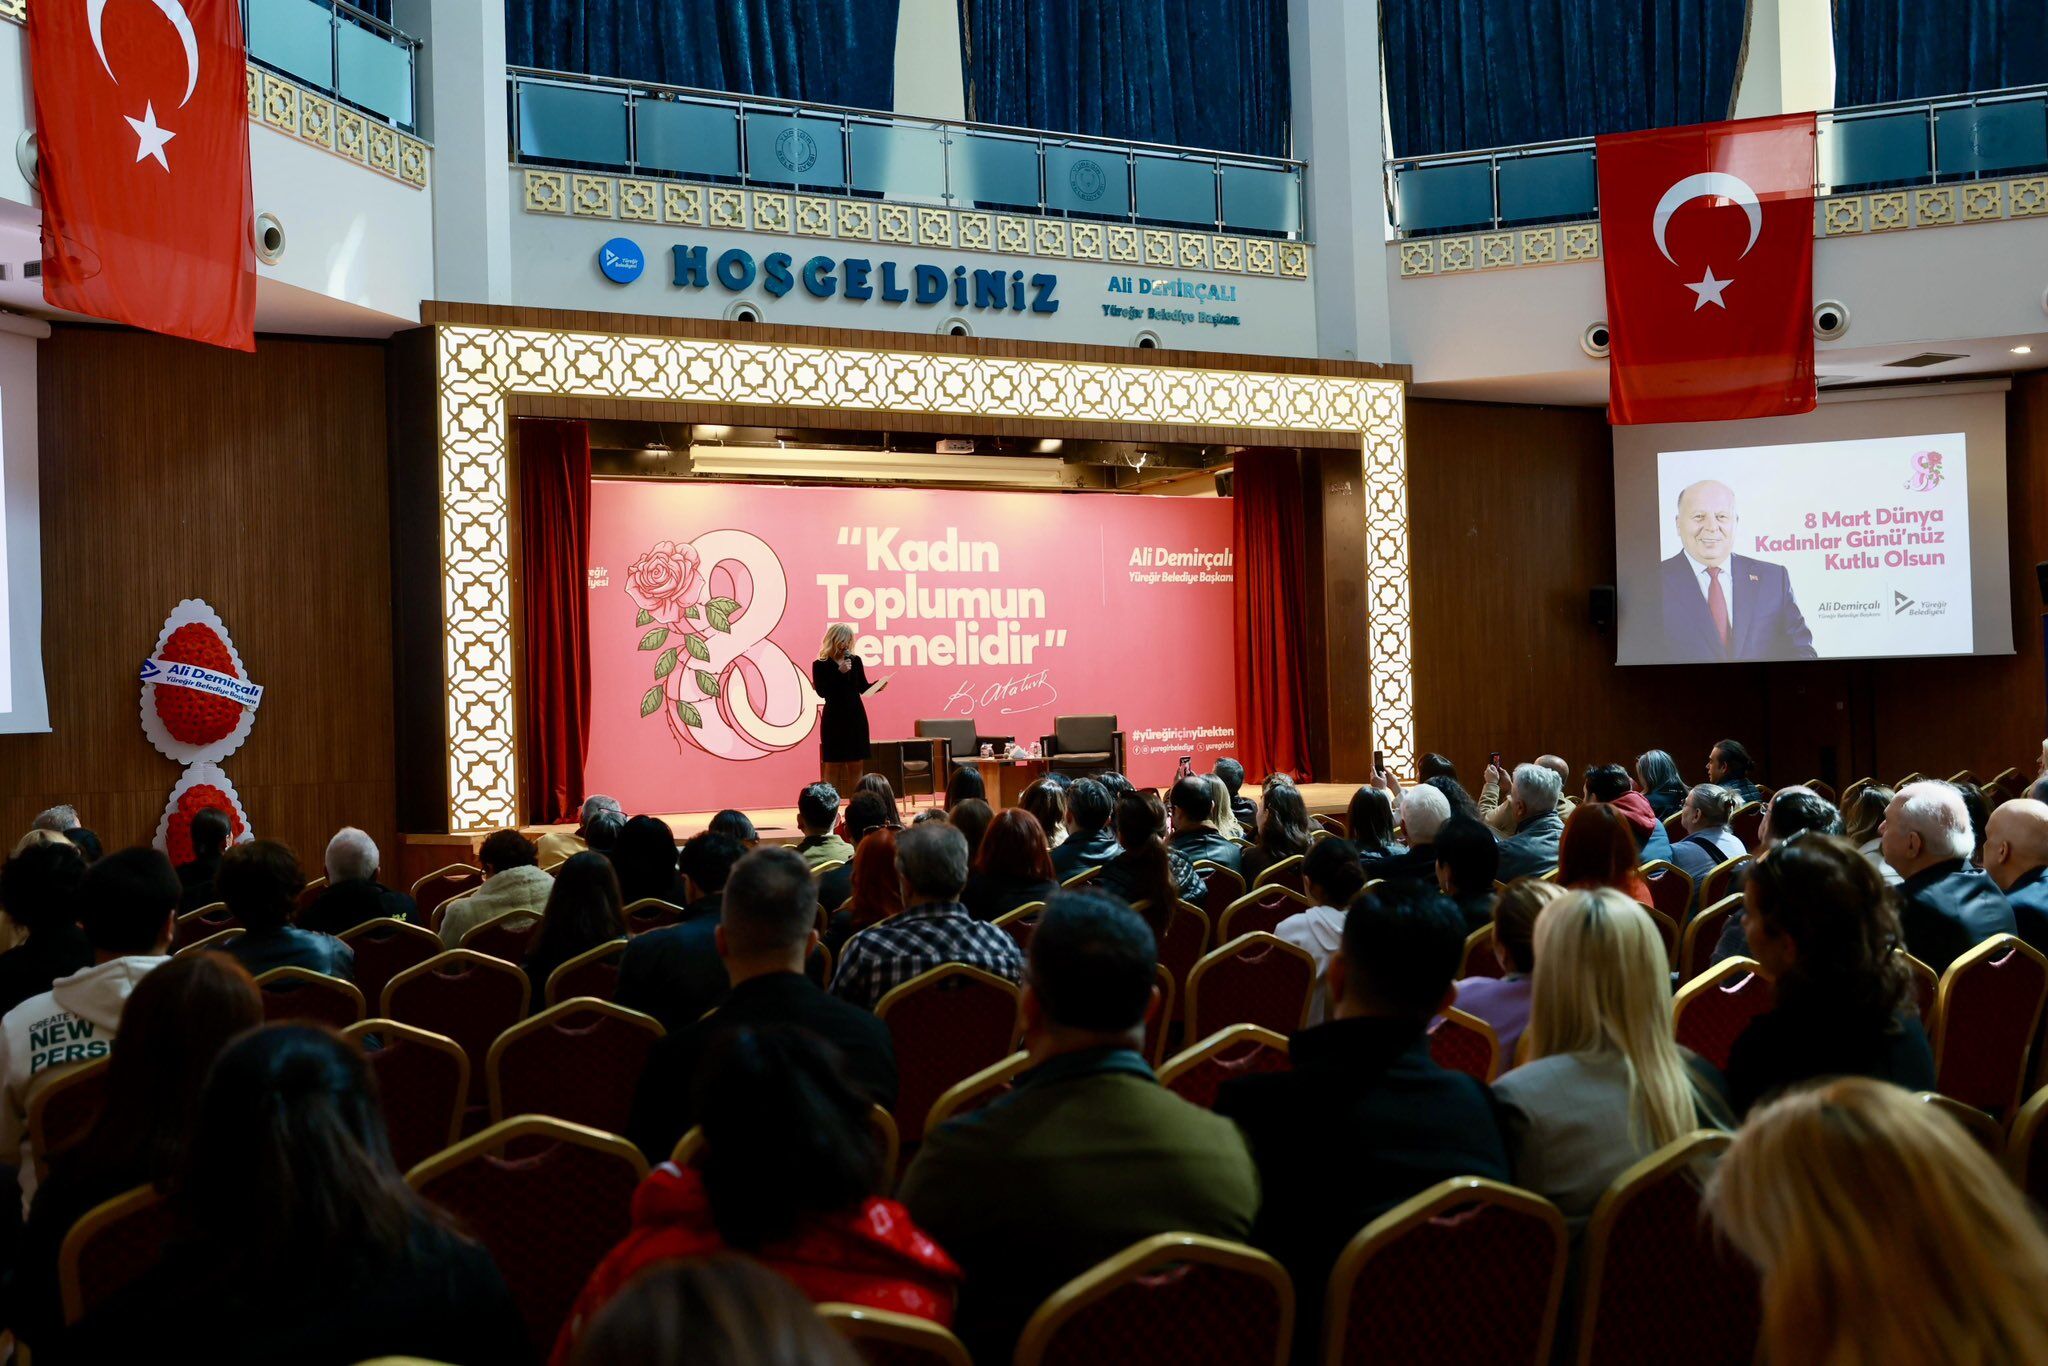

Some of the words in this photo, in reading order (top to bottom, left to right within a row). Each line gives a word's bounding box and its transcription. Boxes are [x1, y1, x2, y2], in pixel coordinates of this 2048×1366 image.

[1108, 276, 1133, 293] Ali
[1804, 513, 1817, 529] 8
[1822, 510, 1871, 528] Mart
[1876, 507, 1944, 526] Dünya
[1755, 533, 1842, 552] Kadınlar
[1129, 547, 1153, 566] Ali
[1155, 547, 1233, 571] Demirçalı
[1825, 552, 1879, 570] Kutlu
[1884, 549, 1945, 568] Olsun
[1129, 571, 1161, 584] Yüreğir
[1162, 572, 1199, 584] Belediye
[816, 573, 1046, 631] Toplumun
[1818, 602, 1832, 611] Ali
[1833, 600, 1880, 612] Demirçalı
[1909, 608, 1946, 616] Belediyesi
[1920, 601, 1947, 609] Yüreğir
[166, 676, 195, 686] Yüreğir
[195, 681, 229, 695] Belediye
[168, 664, 190, 676] Ali
[191, 668, 259, 696] Demirçalı
[29, 1012, 70, 1032] CREATE
[30, 1019, 94, 1051] NEW
[31, 1040, 111, 1074] PERS
